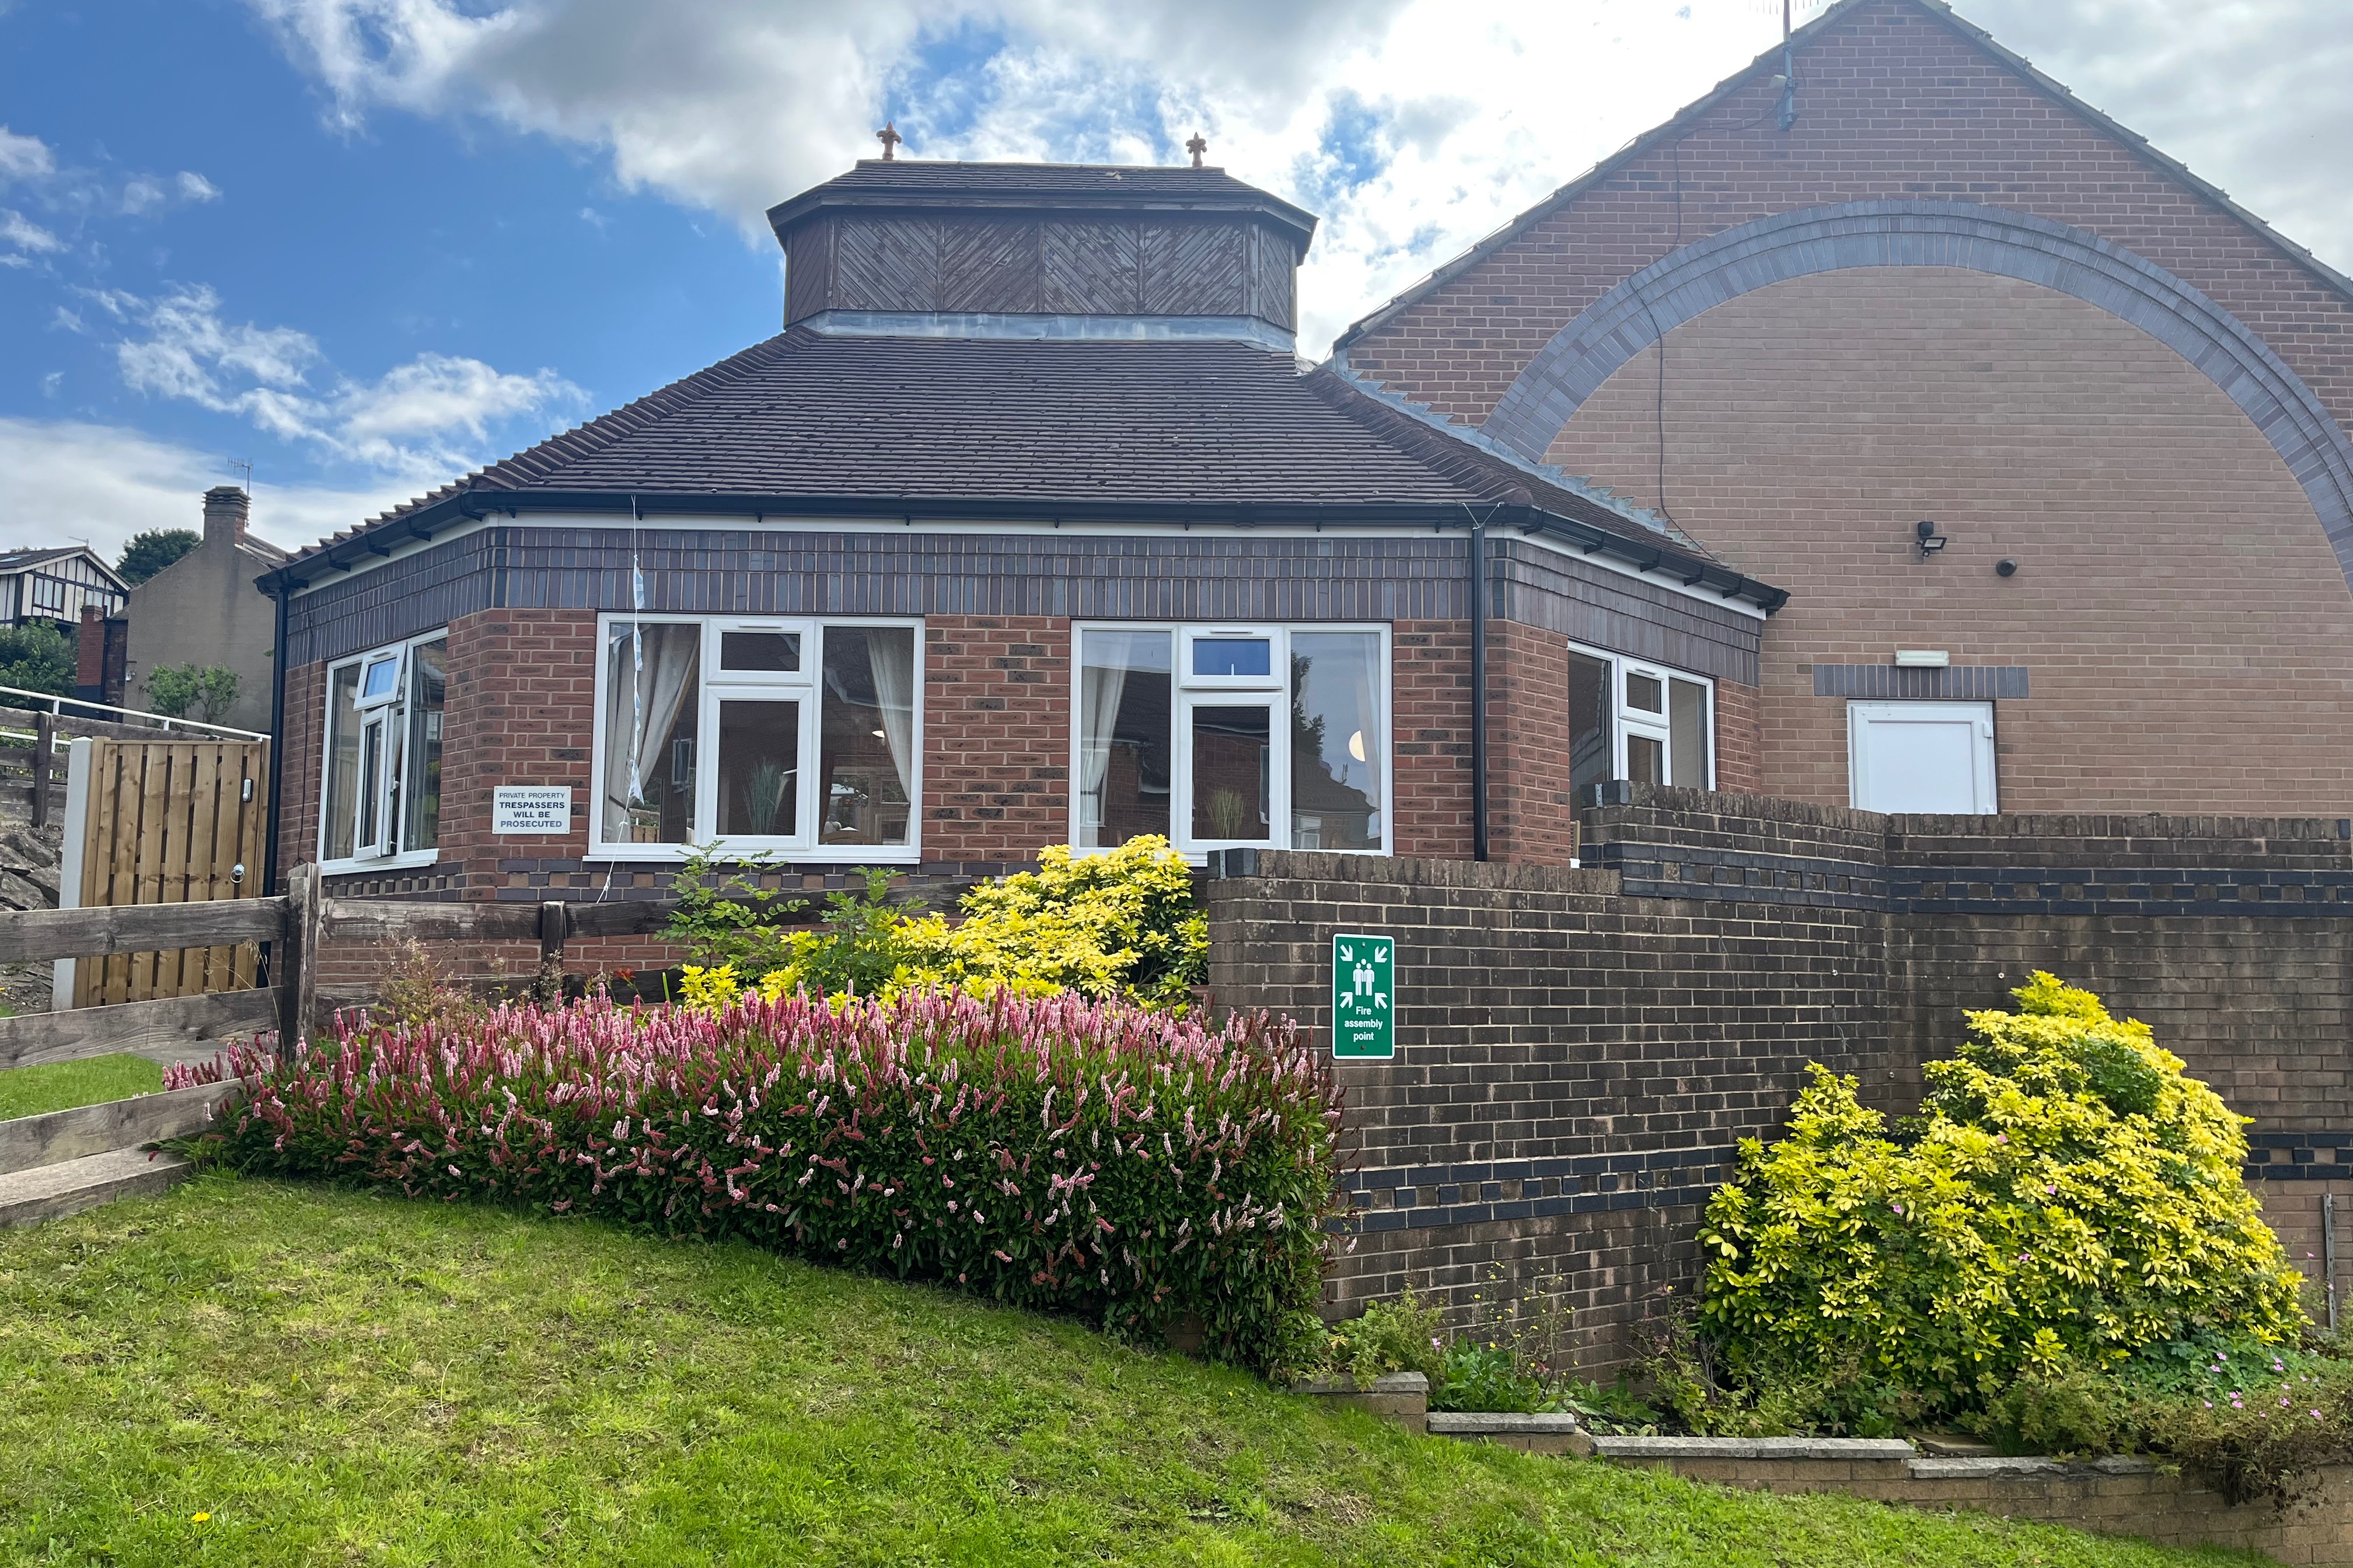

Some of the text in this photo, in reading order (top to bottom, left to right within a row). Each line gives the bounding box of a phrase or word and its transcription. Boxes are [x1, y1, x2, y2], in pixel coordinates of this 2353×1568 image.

[1356, 1005, 1372, 1015] Fire
[1344, 1019, 1383, 1030] assembly
[1353, 1031, 1374, 1043] point
